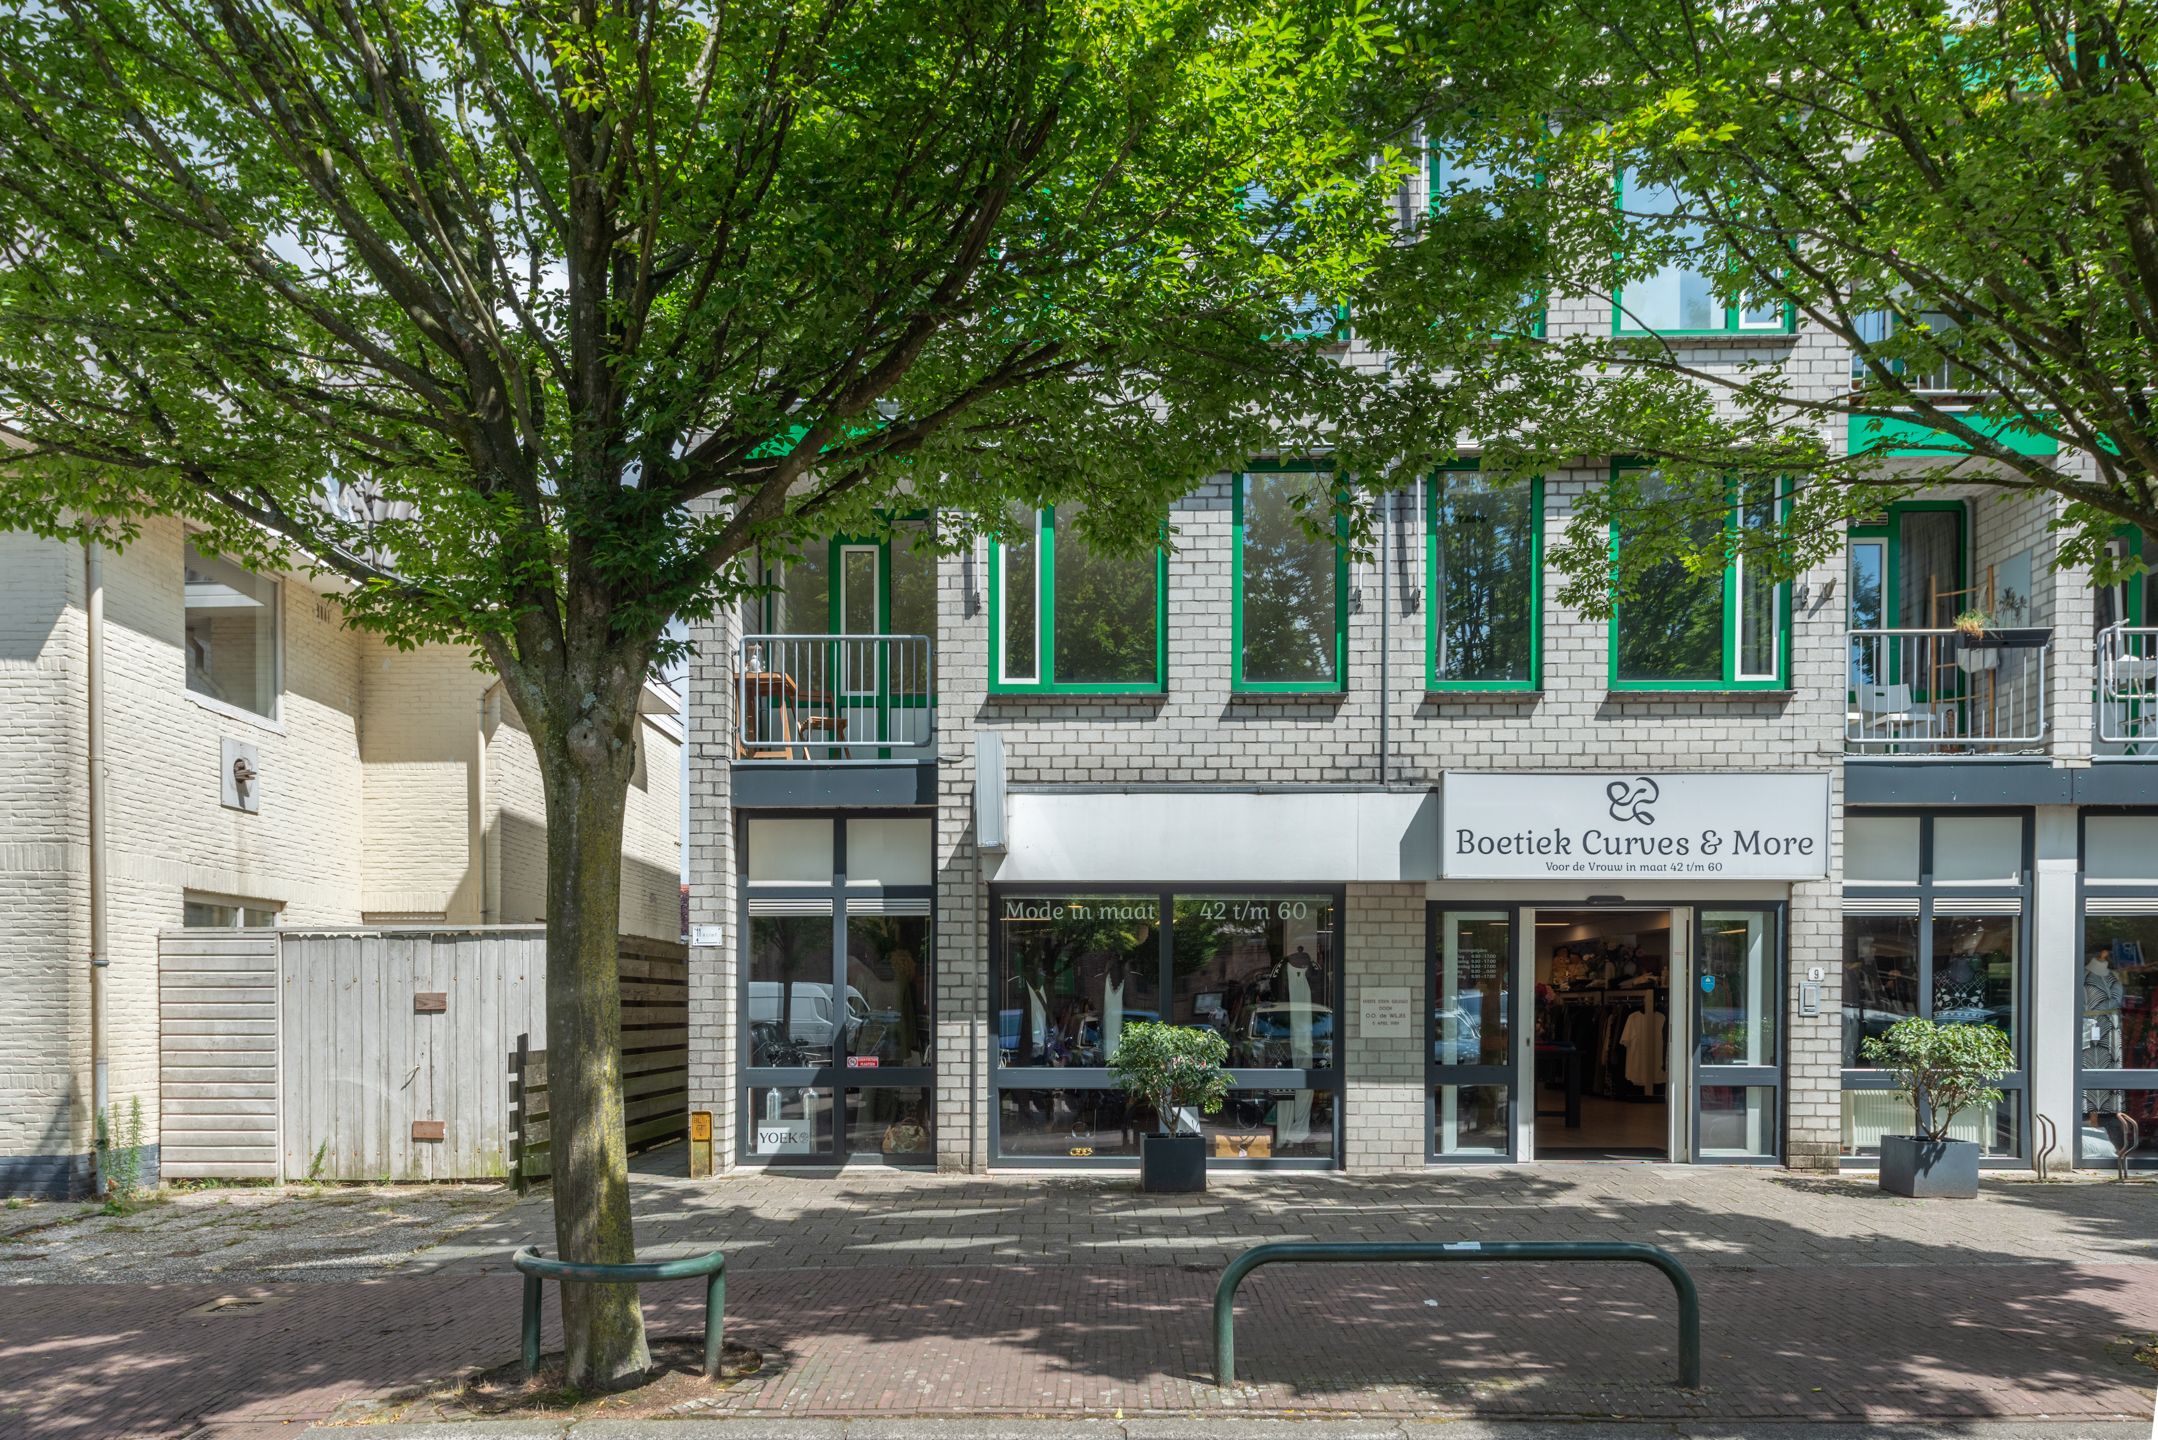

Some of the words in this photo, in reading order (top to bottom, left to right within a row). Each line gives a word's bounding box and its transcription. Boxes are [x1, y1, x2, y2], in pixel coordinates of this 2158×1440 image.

[1456, 828, 1572, 855] Boetiek
[1582, 829, 1690, 855] Curves
[1700, 829, 1723, 855] &
[1732, 830, 1814, 855] More
[1545, 862, 1570, 872] Voor
[1572, 862, 1585, 872] de
[1588, 862, 1623, 872] Vrouw
[1626, 862, 1637, 872] in
[1639, 863, 1667, 872] maat
[1670, 862, 1684, 872] 42
[1686, 862, 1705, 872] t/m
[1708, 862, 1723, 872] 60
[1005, 901, 1064, 920] Mode
[1071, 902, 1092, 920] in
[1099, 903, 1156, 920] maat
[1199, 902, 1227, 920] 42
[1232, 900, 1271, 921] t/m
[1277, 901, 1307, 920] 60
[1813, 969, 1820, 980] 9
[760, 1132, 798, 1144] YOEK
